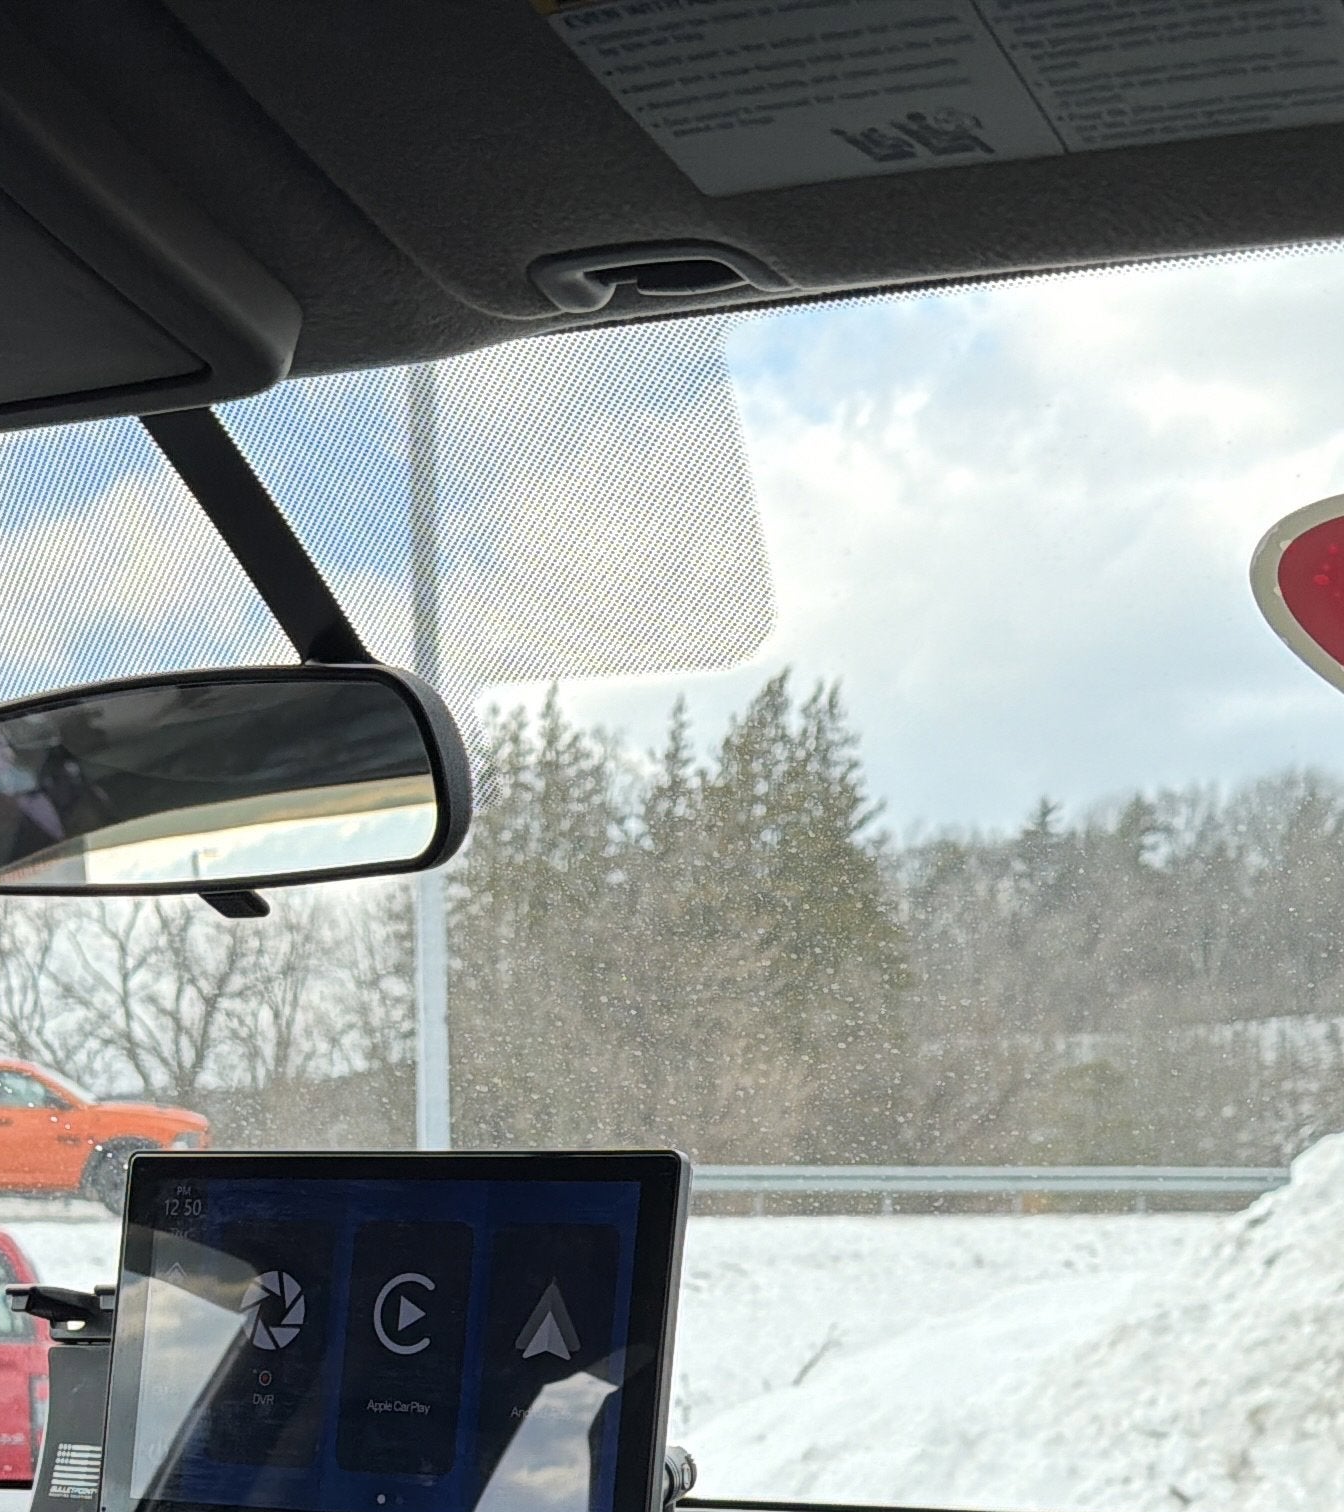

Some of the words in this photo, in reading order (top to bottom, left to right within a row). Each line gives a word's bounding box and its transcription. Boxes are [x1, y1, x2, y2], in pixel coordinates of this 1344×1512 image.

[177, 1186, 192, 1196] PM
[253, 1394, 274, 1405] DVR
[366, 1399, 392, 1413] Apple
